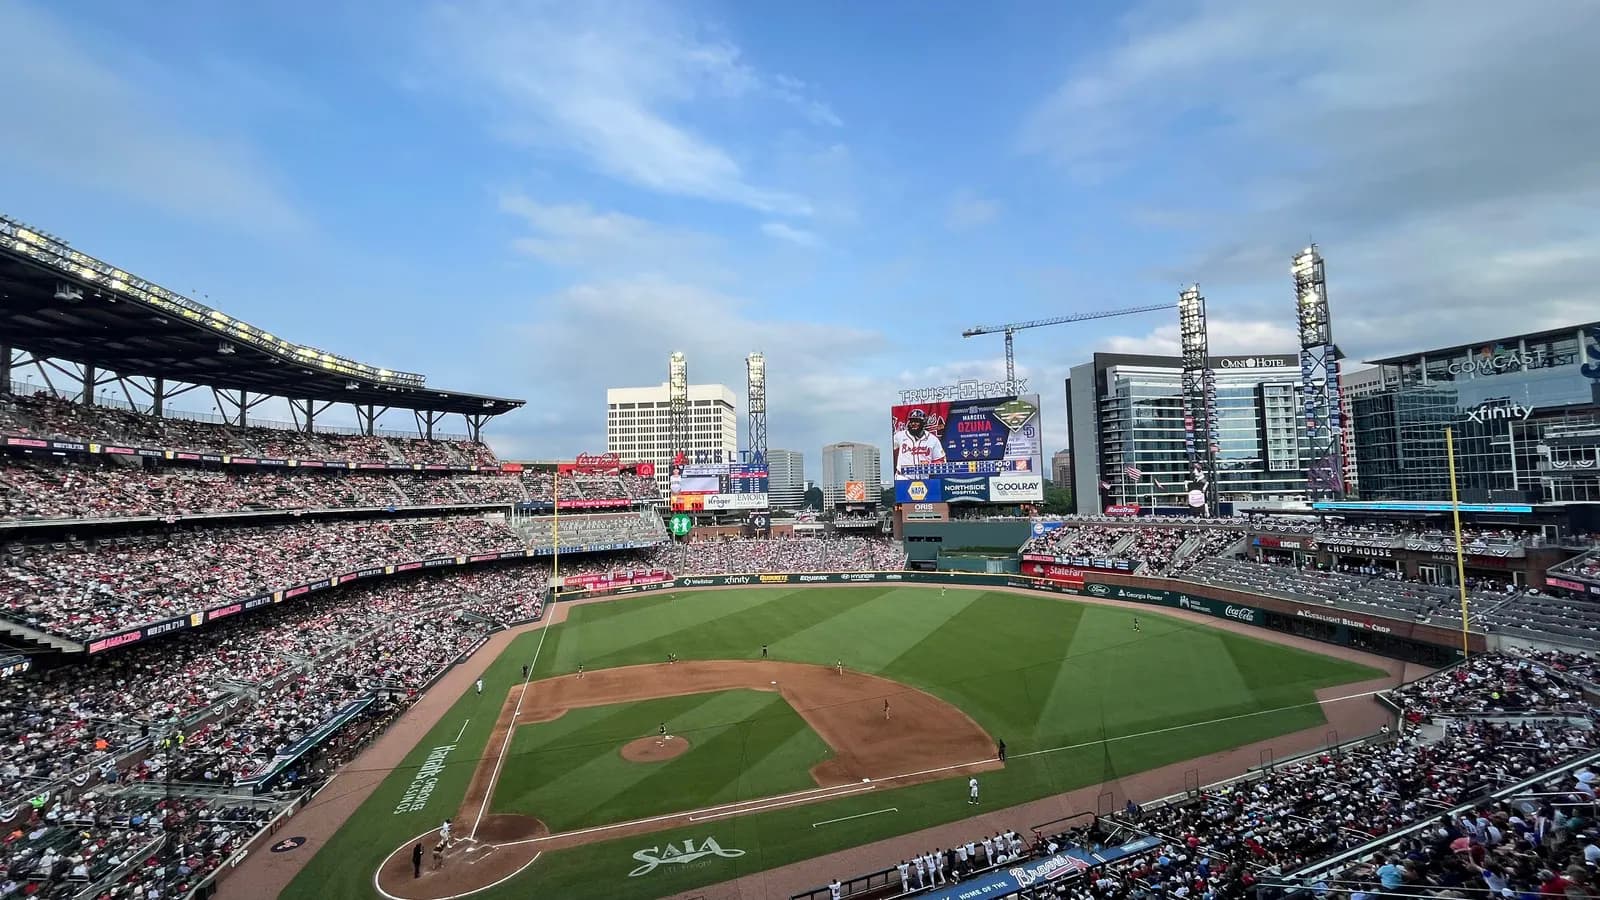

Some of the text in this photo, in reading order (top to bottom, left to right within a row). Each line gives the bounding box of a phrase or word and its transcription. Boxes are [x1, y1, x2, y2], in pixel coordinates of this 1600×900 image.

[1256, 357, 1284, 367] HOTEL
[1449, 351, 1544, 375] COMCAST
[900, 379, 1028, 401] TRUIST PARK
[1467, 404, 1533, 424] xfinity
[957, 421, 992, 433] OZUNA
[911, 486, 925, 494] NAPA
[996, 482, 1039, 491] COOLRAY
[708, 496, 731, 508] Kroger
[1107, 506, 1137, 514] RaceTrac
[1327, 544, 1392, 557] CHOP HOUSE
[724, 575, 750, 584] xfinity
[1126, 592, 1146, 600] Georgia
[393, 780, 424, 814] CASINOS
[960, 889, 982, 900] HOME
[993, 882, 1009, 890] THE
[1009, 854, 1068, 888] Braves
